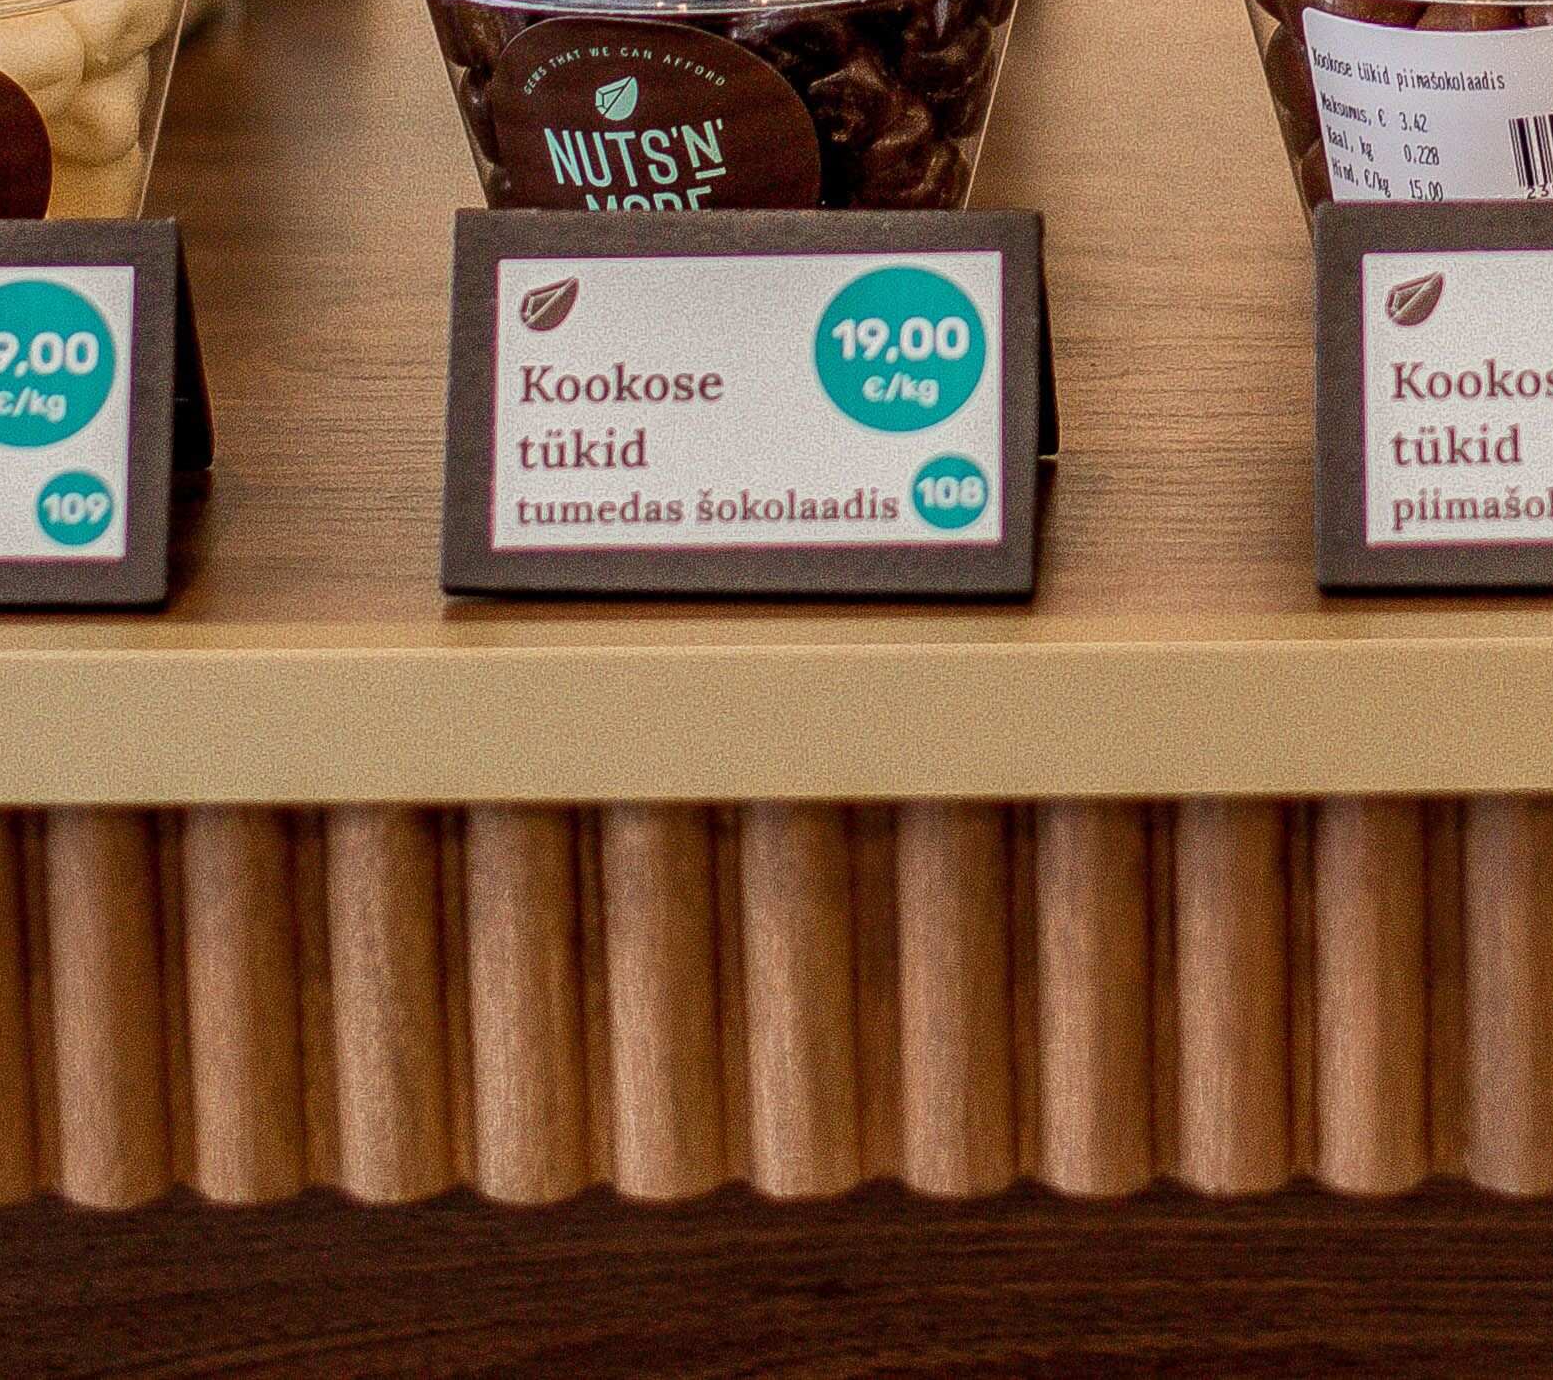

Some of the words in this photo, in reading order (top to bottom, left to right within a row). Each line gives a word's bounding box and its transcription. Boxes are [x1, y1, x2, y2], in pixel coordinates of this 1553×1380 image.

[1357, 60, 1391, 86] tükid
[1396, 70, 1506, 92] piimašokolaadis
[1377, 109, 1387, 128] €
[1399, 112, 1428, 134] 3.42
[544, 118, 727, 188] NUTS'N'
[1359, 138, 1374, 163] kg
[1404, 144, 1441, 166] 0.228
[1364, 171, 1391, 198] €/kg
[1409, 177, 1443, 200] 15.00
[519, 362, 726, 404] Kookose
[862, 372, 940, 407] €/kg
[518, 427, 649, 471] tükid
[1390, 423, 1523, 467] tükid
[44, 491, 109, 525] 109
[518, 491, 684, 526] tumedas
[695, 488, 900, 524] šokolaadis
[915, 474, 985, 510] 108
